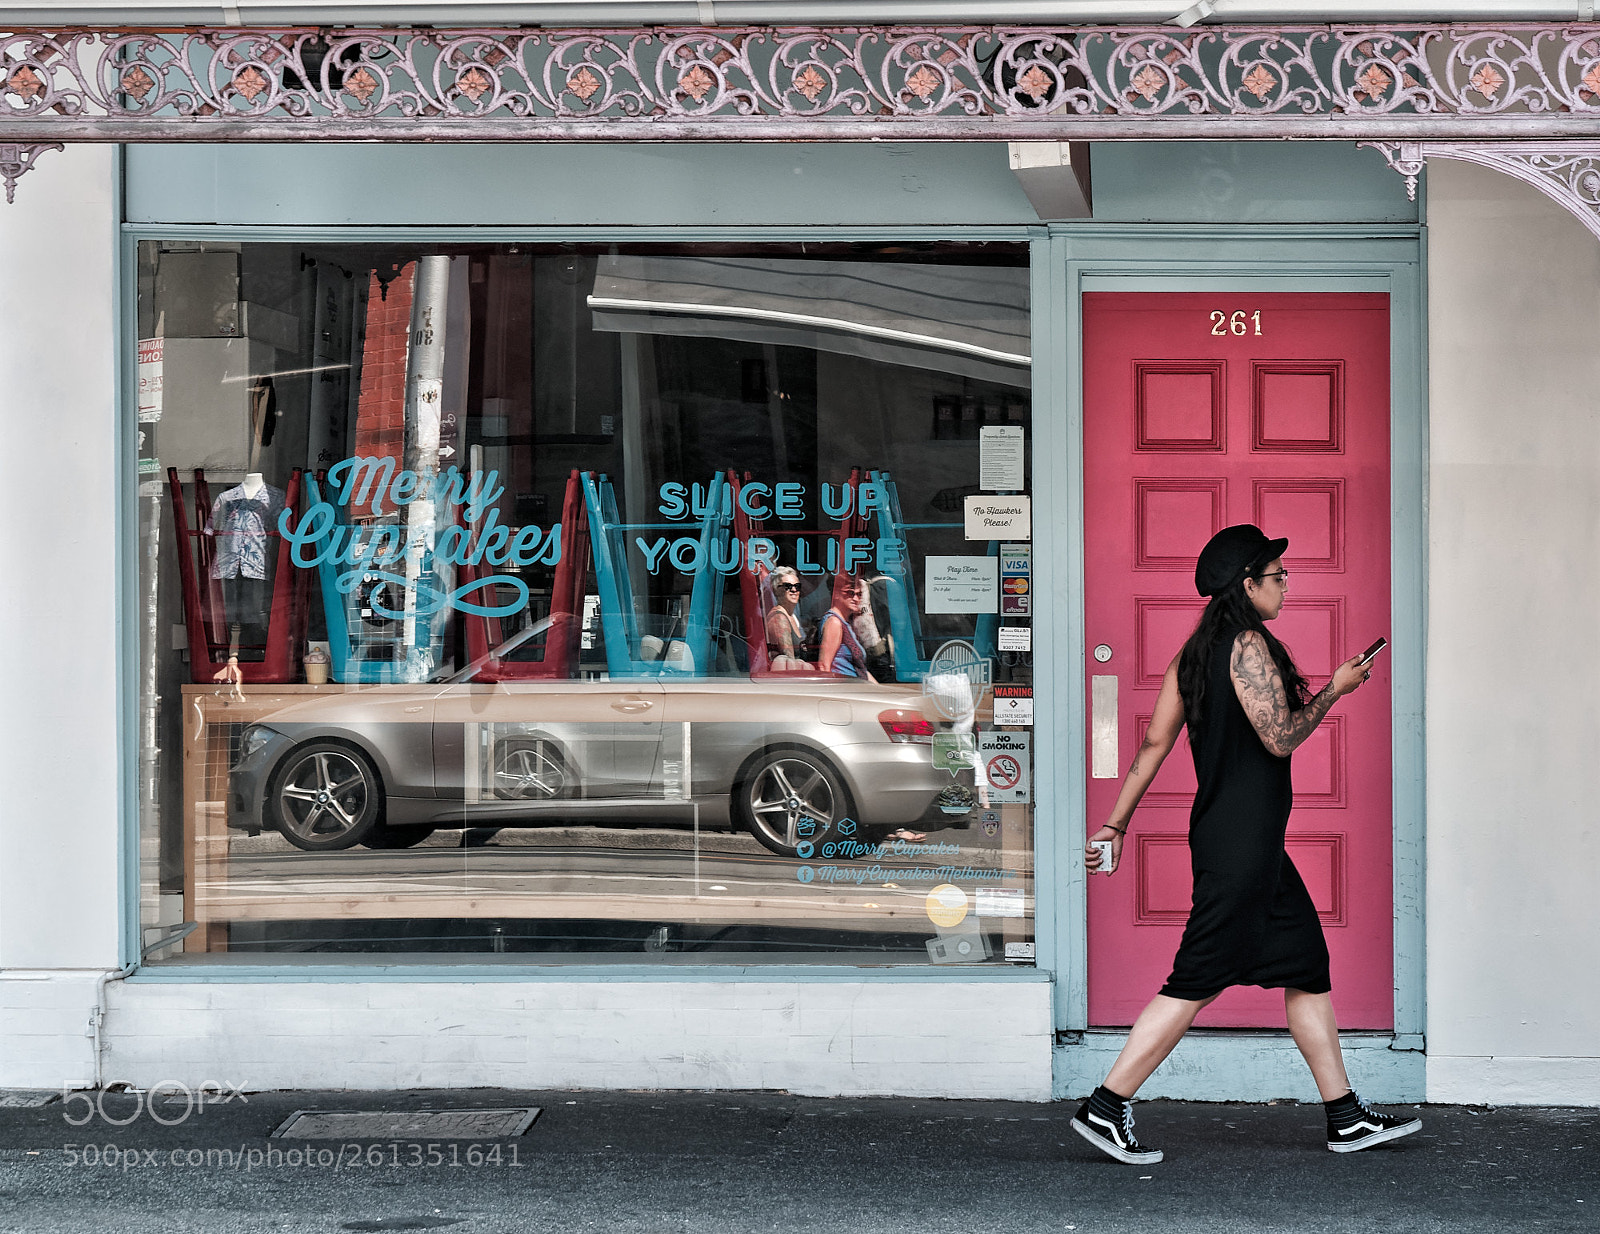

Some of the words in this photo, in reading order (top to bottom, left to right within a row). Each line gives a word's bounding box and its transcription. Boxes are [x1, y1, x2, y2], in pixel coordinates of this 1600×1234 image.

[1209, 309, 1263, 336] 261
[327, 455, 505, 523] Merry
[658, 482, 806, 521] SLICE
[821, 482, 890, 521] UP
[973, 506, 985, 516] No
[986, 506, 1022, 515] Hawkers
[984, 518, 1012, 526] Please!
[277, 507, 563, 594] Cupcakes
[635, 537, 780, 576] YOUR
[796, 537, 908, 576] LIFE
[1005, 561, 1028, 570] VISA
[994, 687, 1033, 697] WARNING
[821, 839, 960, 860] @Merry_Cupcakes
